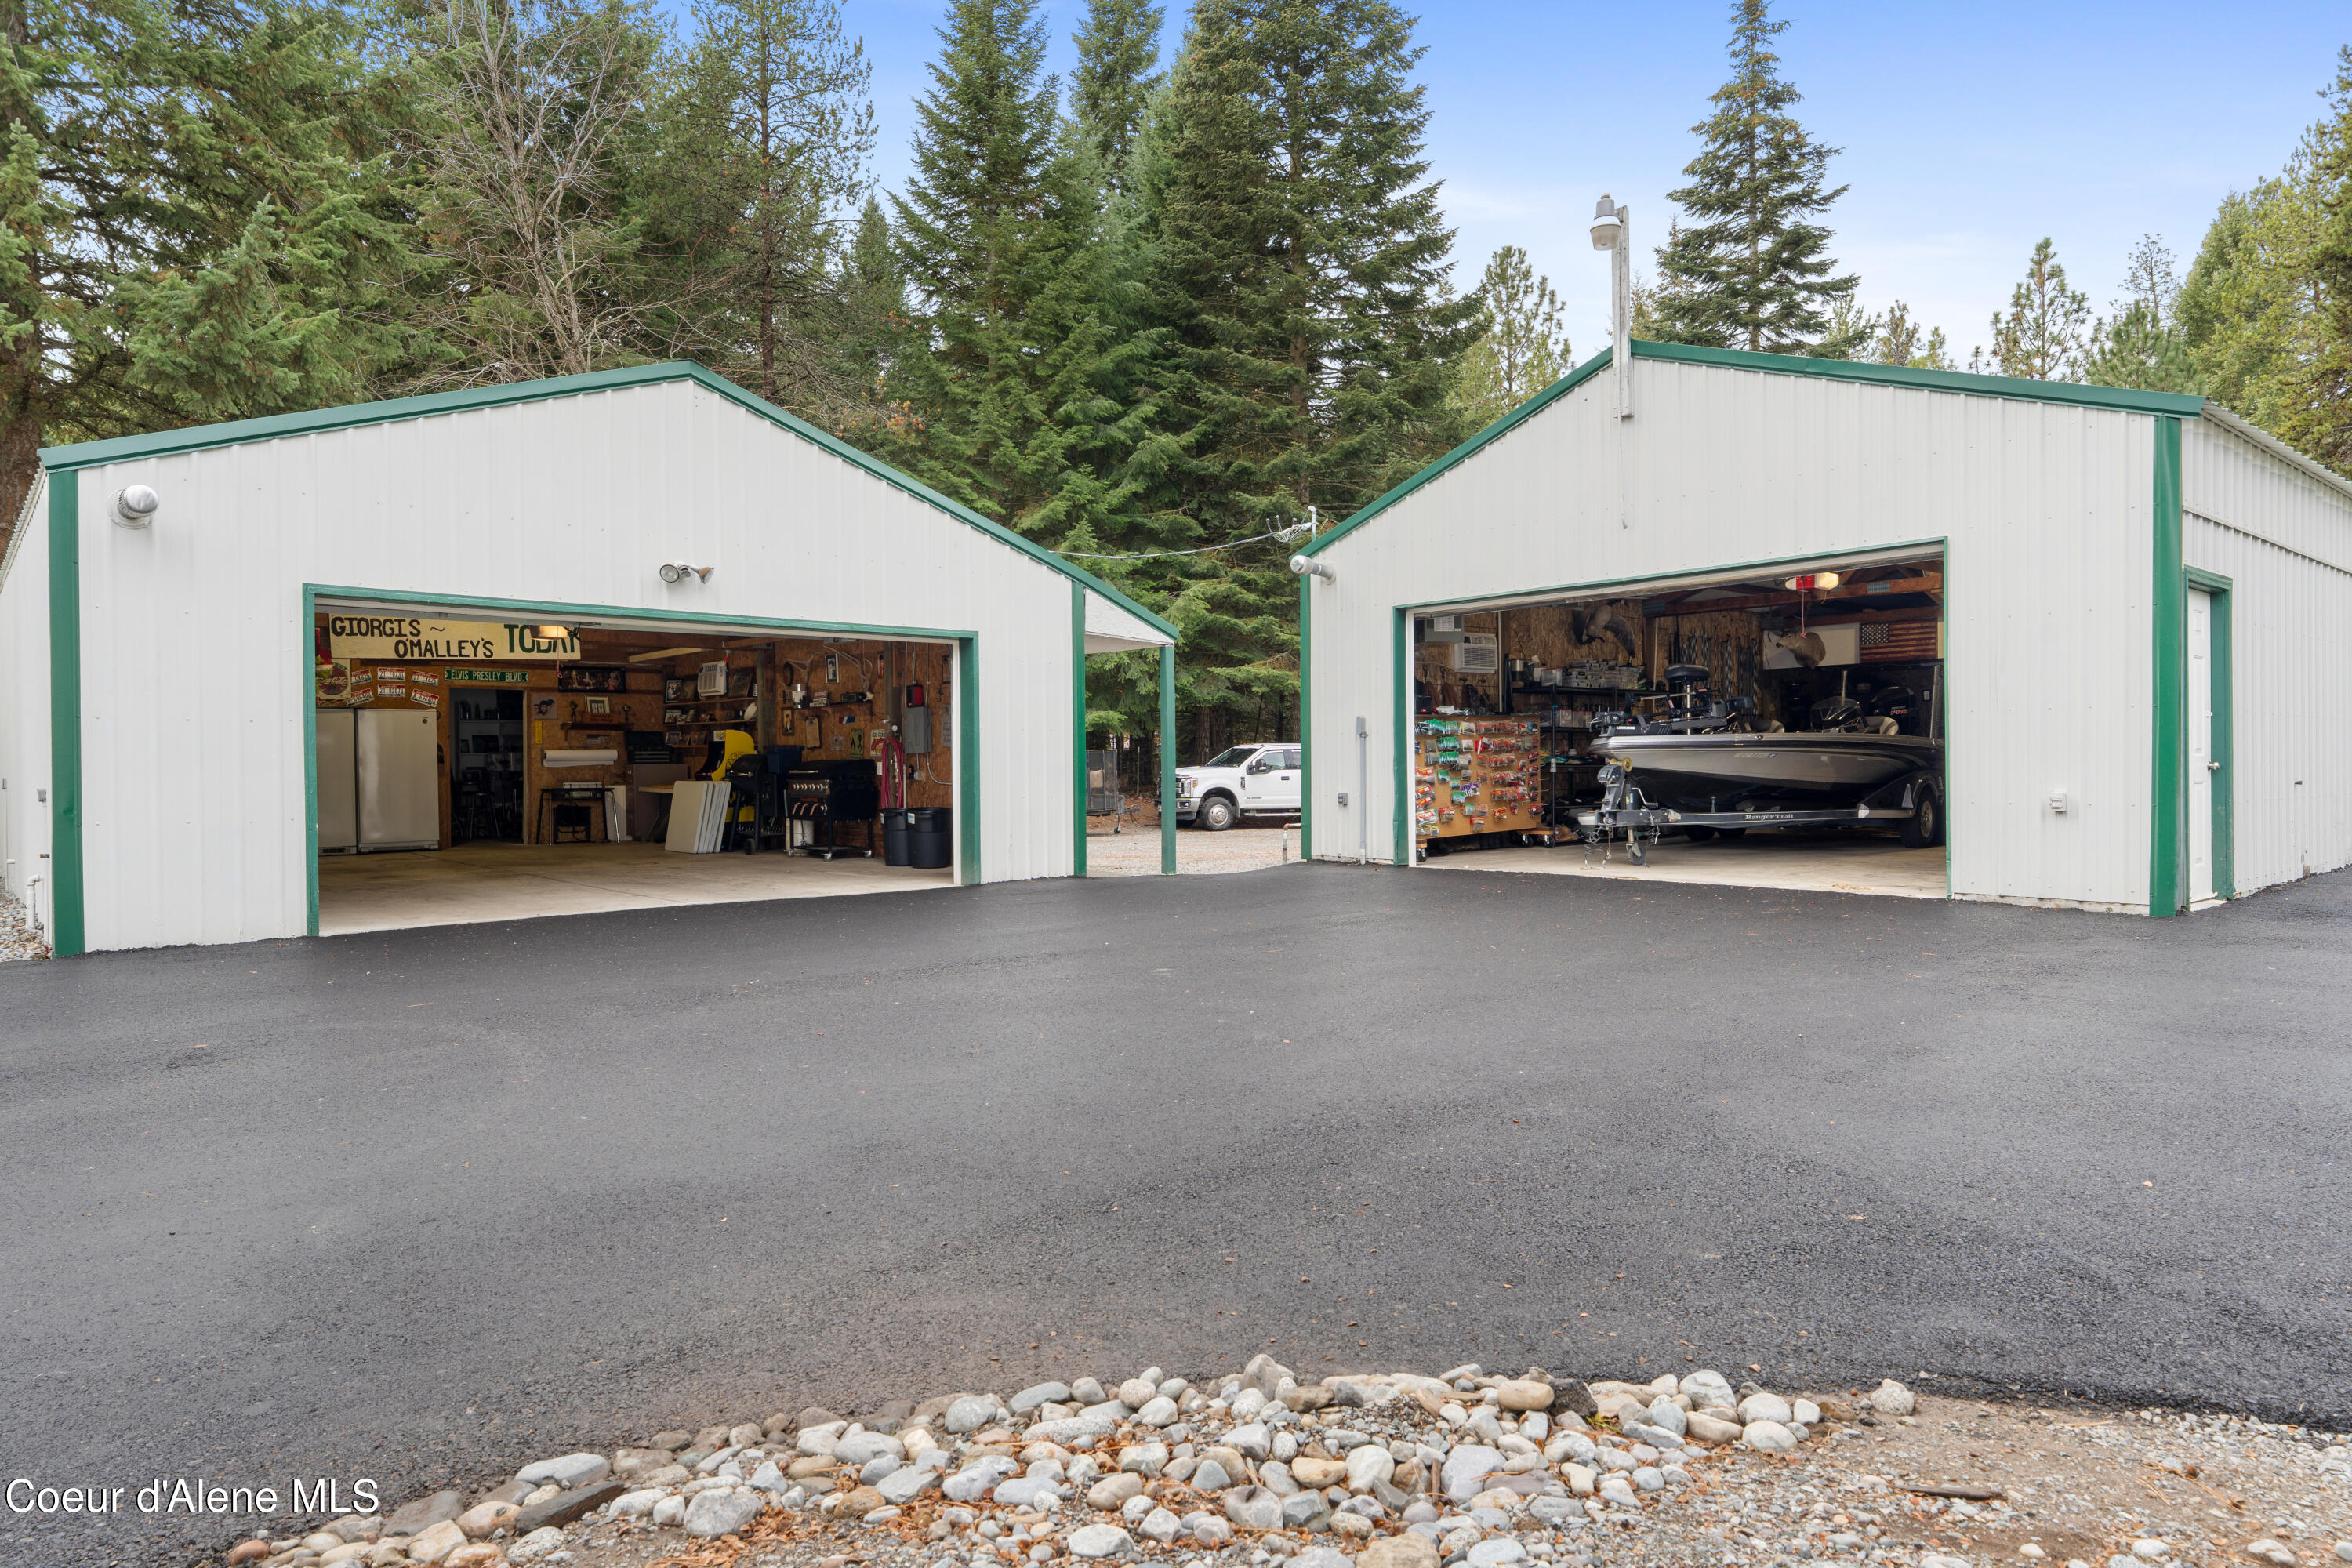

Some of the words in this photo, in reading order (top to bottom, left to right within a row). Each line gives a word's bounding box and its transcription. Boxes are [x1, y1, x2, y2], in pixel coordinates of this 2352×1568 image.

[331, 616, 421, 637] GIORGIS
[394, 637, 494, 659] O'MALLEY'S
[451, 670, 469, 680] ELVIS
[472, 671, 501, 681] PRESLEY
[505, 672, 524, 682] BLVD.
